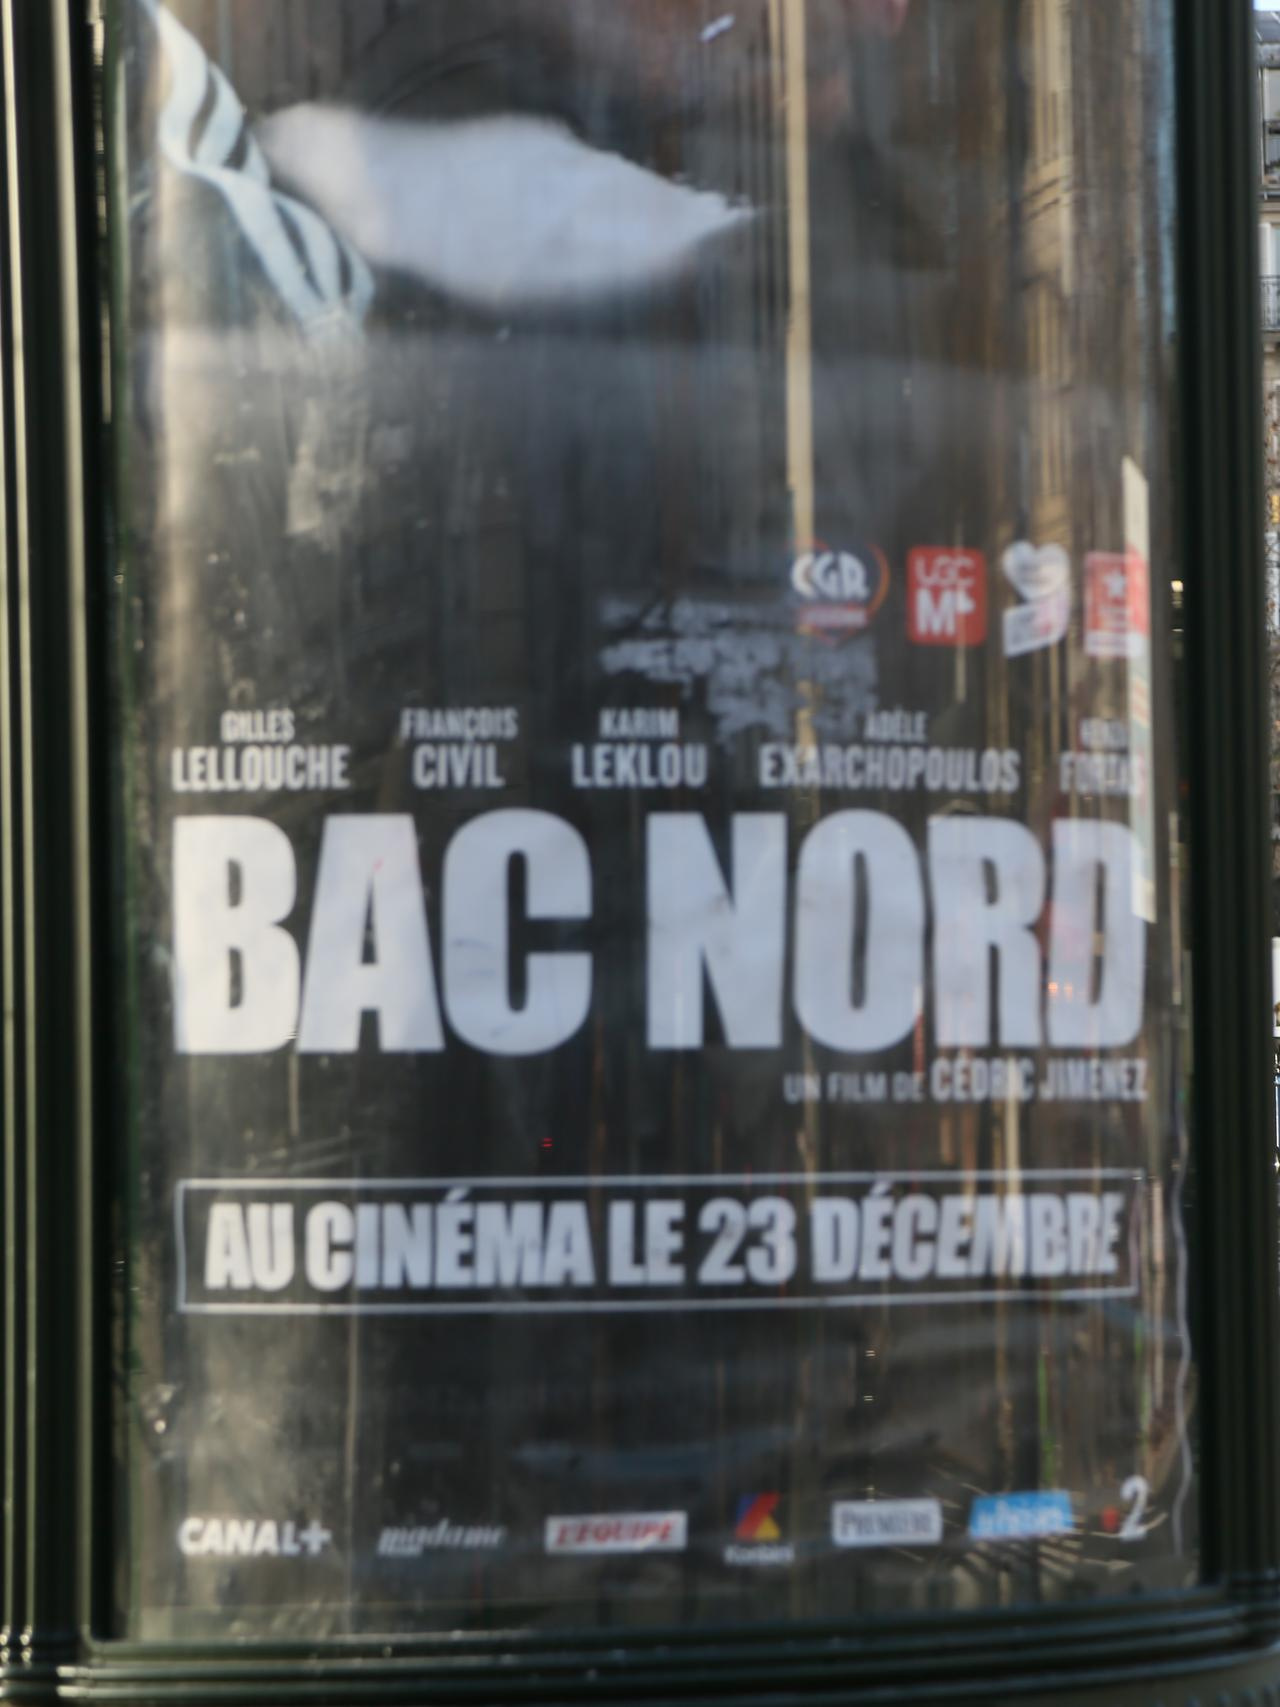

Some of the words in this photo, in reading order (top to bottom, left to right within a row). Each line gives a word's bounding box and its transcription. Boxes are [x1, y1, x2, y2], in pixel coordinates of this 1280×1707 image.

[790, 551, 869, 600] CGR
[914, 554, 976, 587] UGC
[220, 708, 296, 743] GILLES
[401, 706, 518, 743] FRANÇOIS
[600, 707, 680, 740] KARIM
[171, 744, 351, 792] LELLOUCHE
[412, 743, 506, 789] CIVIL
[571, 743, 708, 789] LEKLOU
[758, 745, 1021, 792] EXARCHOPOULOS
[172, 807, 594, 1057] BAC
[644, 807, 1148, 1054] NORD
[784, 1073, 820, 1103] UN
[827, 1071, 886, 1101] FILM
[893, 1073, 926, 1101] DE
[931, 1055, 1034, 1100] CÉDRIC
[1038, 1057, 1149, 1100] JIMENEZ
[204, 1201, 296, 1291] AU
[304, 1186, 597, 1292] CINÉMA
[608, 1199, 686, 1287] LE
[698, 1196, 797, 1286] 23
[810, 1180, 1128, 1283] DÉCEMBRE
[1119, 1474, 1150, 1542] 2
[177, 1517, 332, 1557] CANAL+
